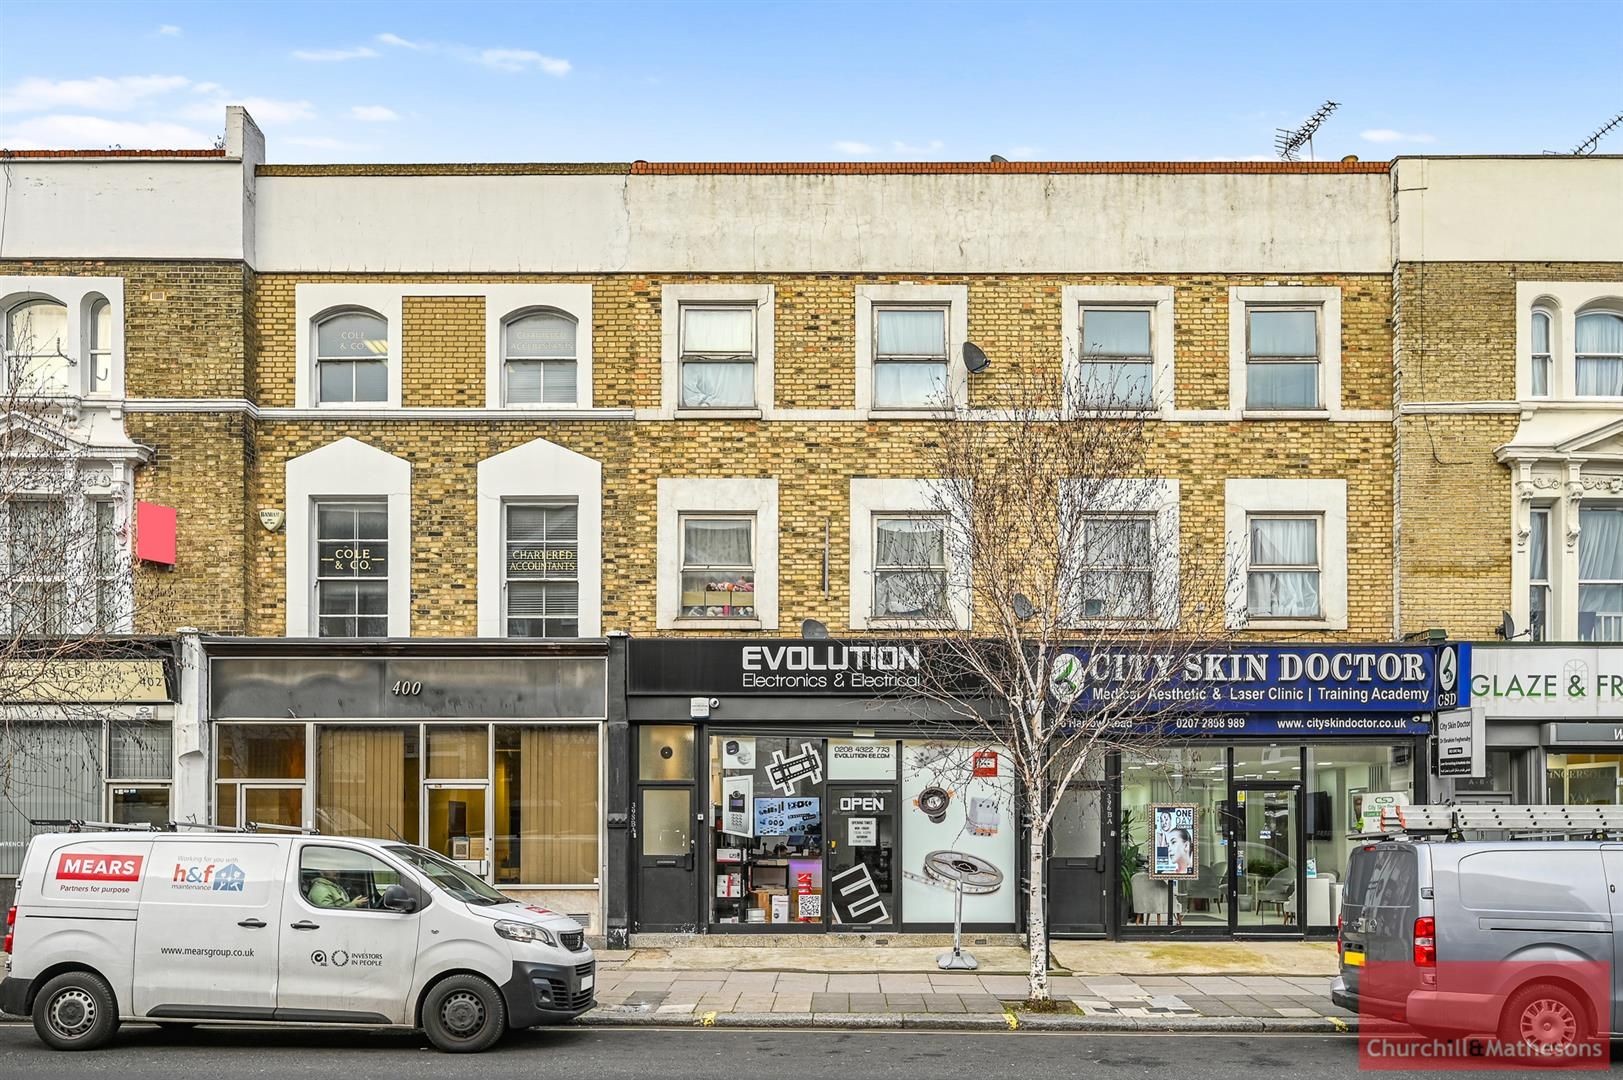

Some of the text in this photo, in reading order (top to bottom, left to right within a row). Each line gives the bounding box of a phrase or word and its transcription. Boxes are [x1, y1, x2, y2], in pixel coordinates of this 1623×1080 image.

[335, 549, 370, 559] COLE
[512, 550, 573, 560] CHARTERED
[335, 560, 371, 570] & CO.
[510, 562, 575, 571] ACCOUNTANTS
[742, 646, 920, 670] EVOLUTION
[1089, 652, 1426, 682] CITY SKIN DOCTOR
[140, 677, 162, 687] 402
[742, 672, 920, 688] Electronics & Electrical
[1471, 674, 1557, 697] GLAZE
[1567, 674, 1586, 697] &
[392, 680, 422, 695] 400
[1147, 687, 1206, 700] Aesthetic
[1212, 687, 1222, 700] &
[1230, 687, 1265, 700] Laser
[1268, 686, 1304, 701] Clinic
[1318, 686, 1368, 703] Training
[1371, 686, 1429, 703] Academy
[1438, 693, 1457, 707] CSD
[1176, 717, 1200, 729] 0207
[1227, 717, 1245, 729] 989
[1277, 719, 1304, 729] www.
[1306, 717, 1407, 733] cityskindoctor.co.uk
[1439, 720, 1470, 731] City Skin Doctor
[840, 797, 884, 811] OPEN
[1175, 809, 1192, 817] ONE
[1175, 817, 1192, 825] DAY
[178, 855, 203, 863] Working
[63, 859, 135, 875] MEARS
[173, 863, 215, 883] h&f
[60, 884, 88, 893] Partners
[101, 887, 130, 895] purpose
[160, 947, 255, 958] www.mearsgroup.co.uk
